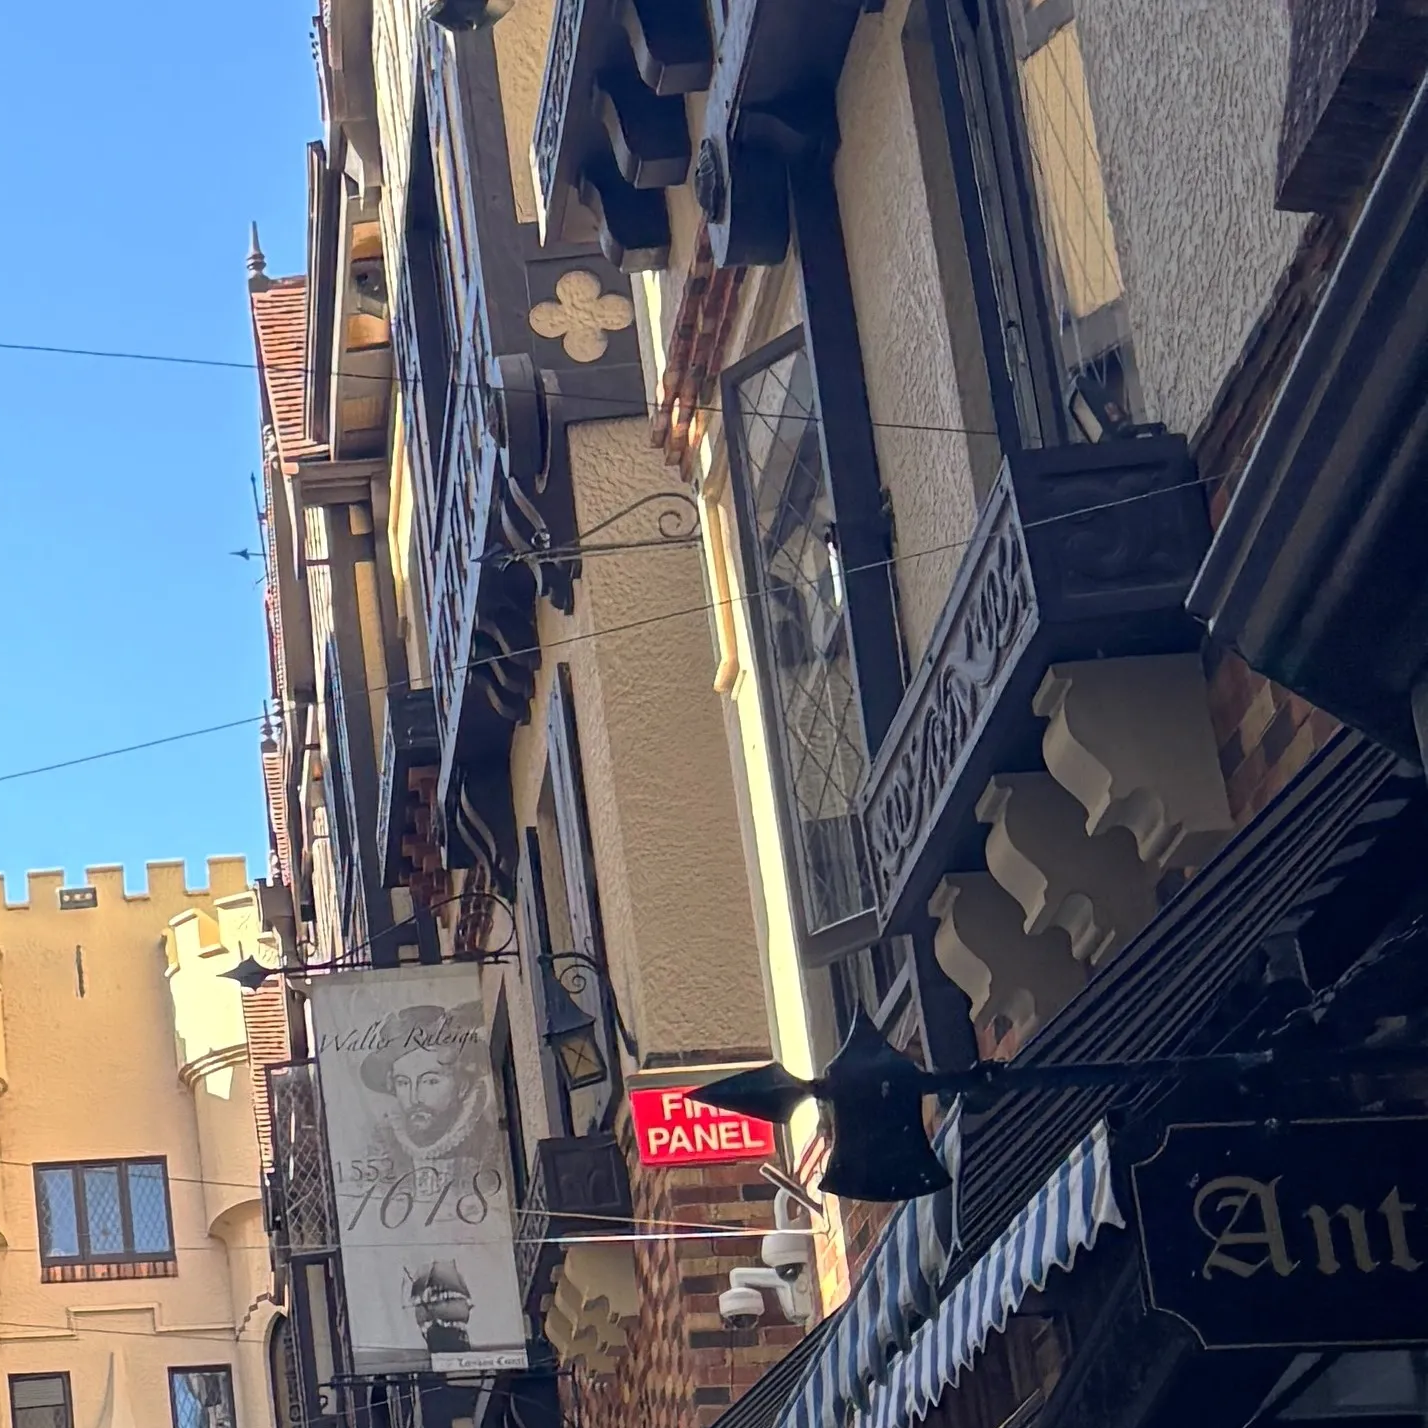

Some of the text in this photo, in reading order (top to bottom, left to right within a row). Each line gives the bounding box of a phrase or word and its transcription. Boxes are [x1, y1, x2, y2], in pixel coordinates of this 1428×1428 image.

[320, 1014, 482, 1055] Walter Raleigh
[647, 1119, 766, 1155] PANEL
[335, 1159, 396, 1185] 1552
[346, 1166, 502, 1231] 1618
